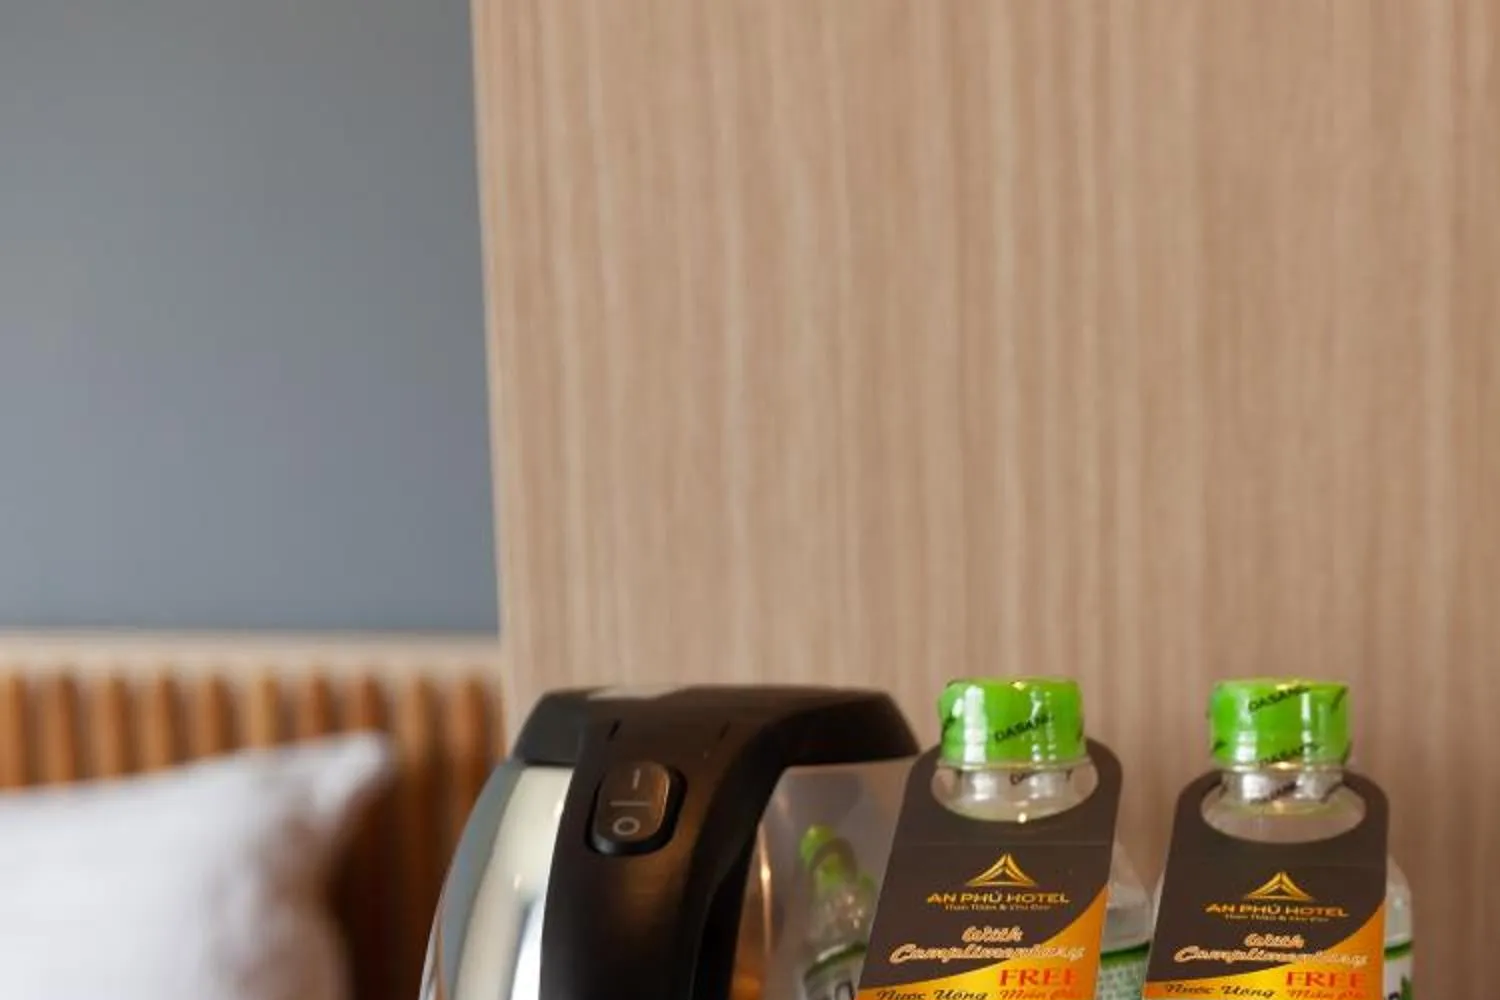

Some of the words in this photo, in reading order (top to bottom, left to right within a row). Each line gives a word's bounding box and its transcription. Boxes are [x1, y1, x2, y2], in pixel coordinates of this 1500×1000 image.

[927, 892, 957, 904] AN
[1006, 892, 1070, 904] HOTEL
[1205, 903, 1235, 913] AN
[1285, 904, 1349, 917] HOTEL
[1000, 967, 1078, 987] FREE
[1286, 971, 1367, 988] FREE
